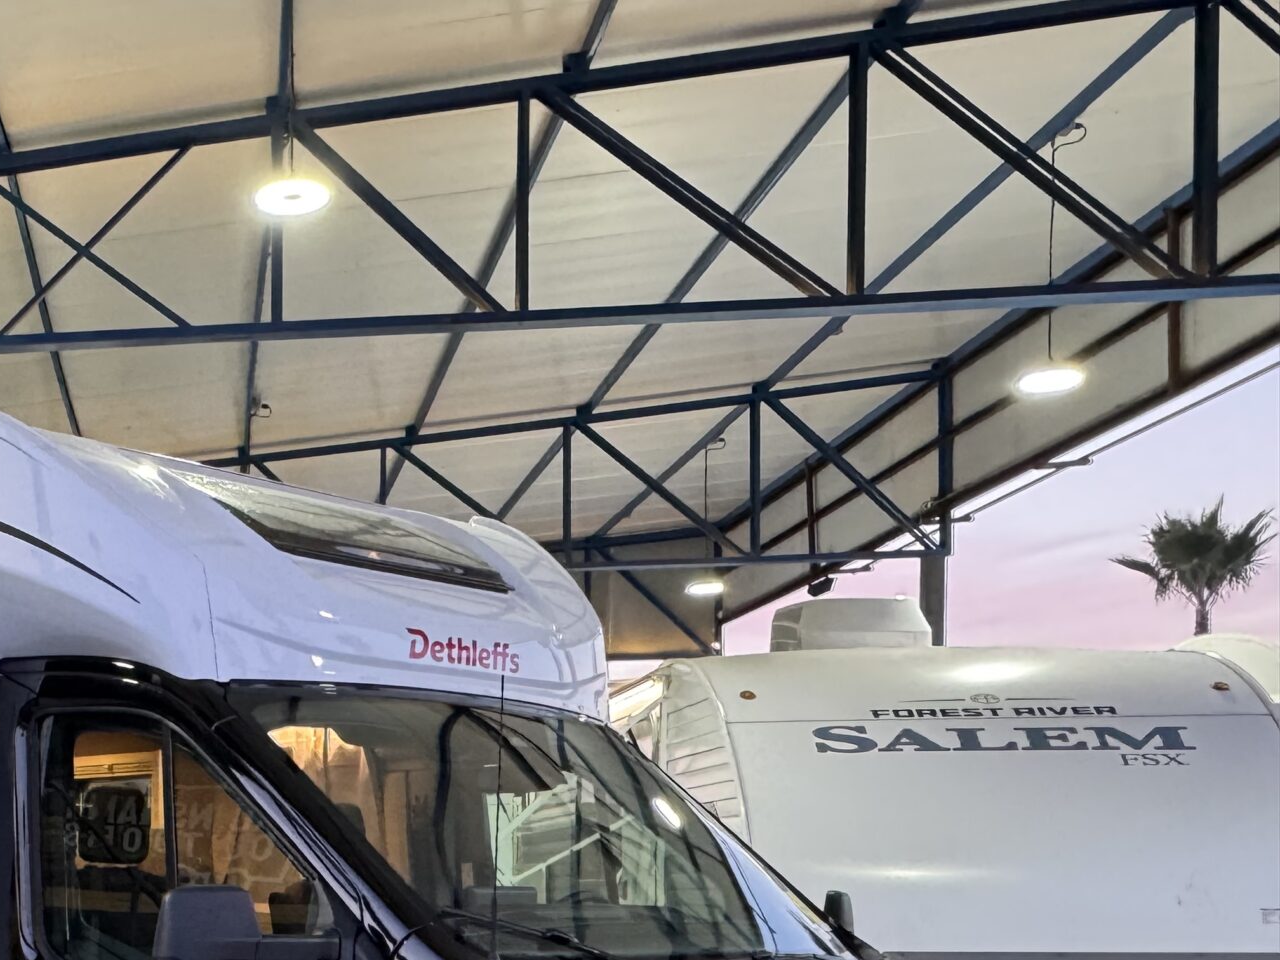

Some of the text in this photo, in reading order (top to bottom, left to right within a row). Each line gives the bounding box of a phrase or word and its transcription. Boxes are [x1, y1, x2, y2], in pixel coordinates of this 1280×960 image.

[405, 627, 519, 673] Dethleffs
[870, 705, 1118, 719] FOREST RIVER
[811, 725, 1197, 754] SALEM
[1120, 753, 1191, 766] FSX
